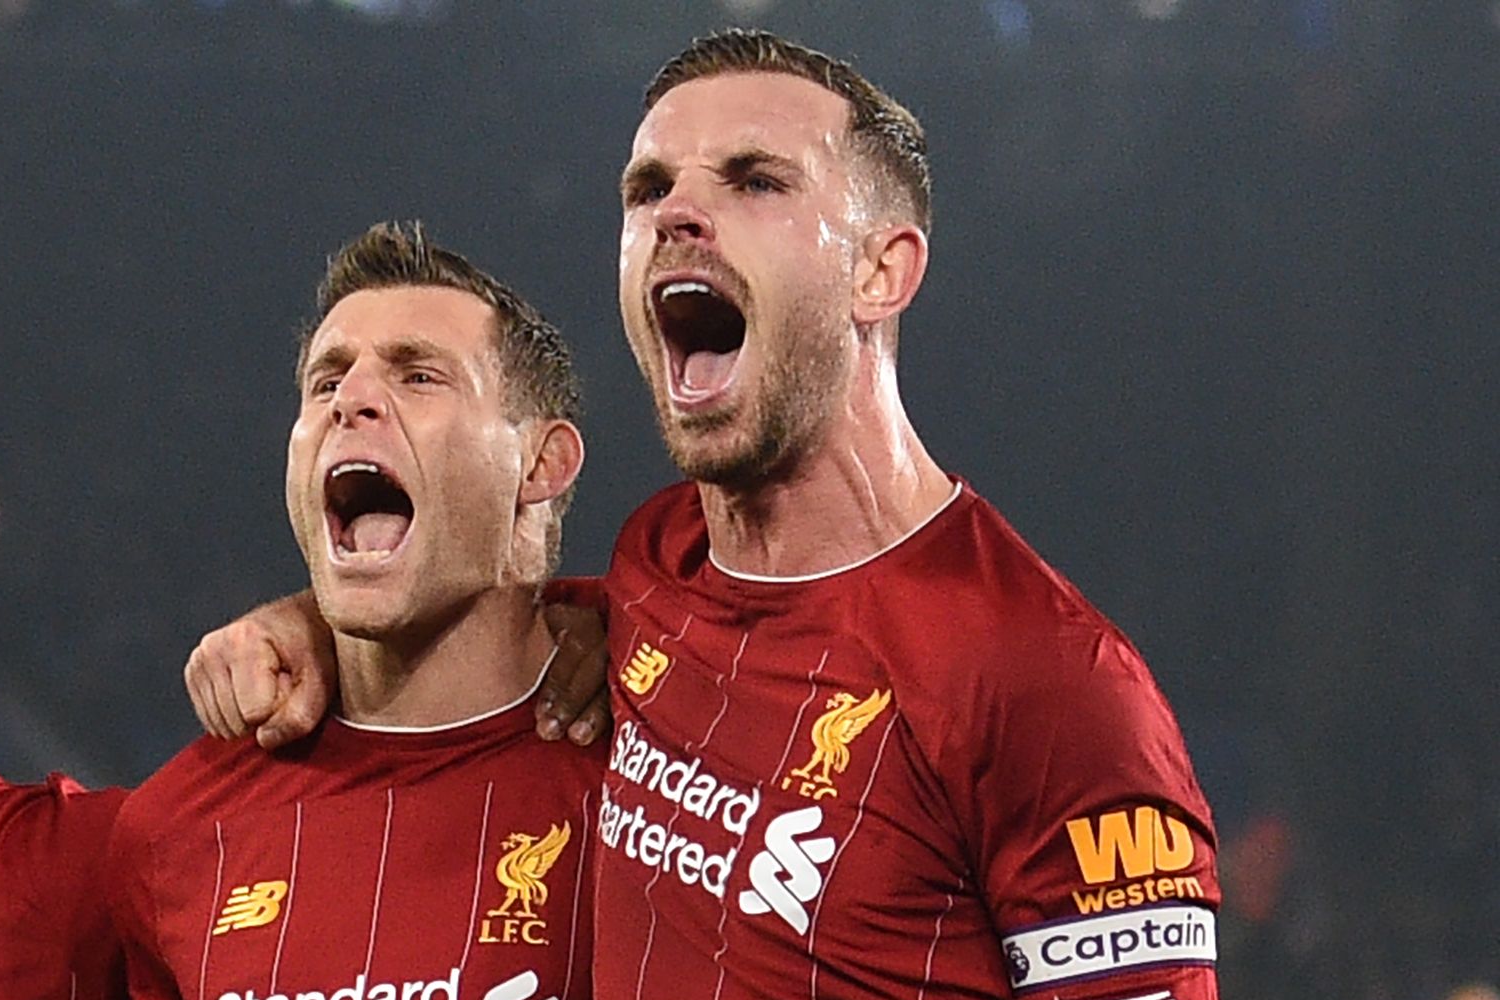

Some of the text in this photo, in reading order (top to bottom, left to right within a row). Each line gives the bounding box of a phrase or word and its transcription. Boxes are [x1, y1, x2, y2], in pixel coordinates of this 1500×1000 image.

[609, 720, 760, 836] Standard
[597, 782, 738, 898] hartered
[1065, 806, 1195, 884] WU
[1071, 876, 1204, 915] Western
[1041, 912, 1206, 964] Captain
